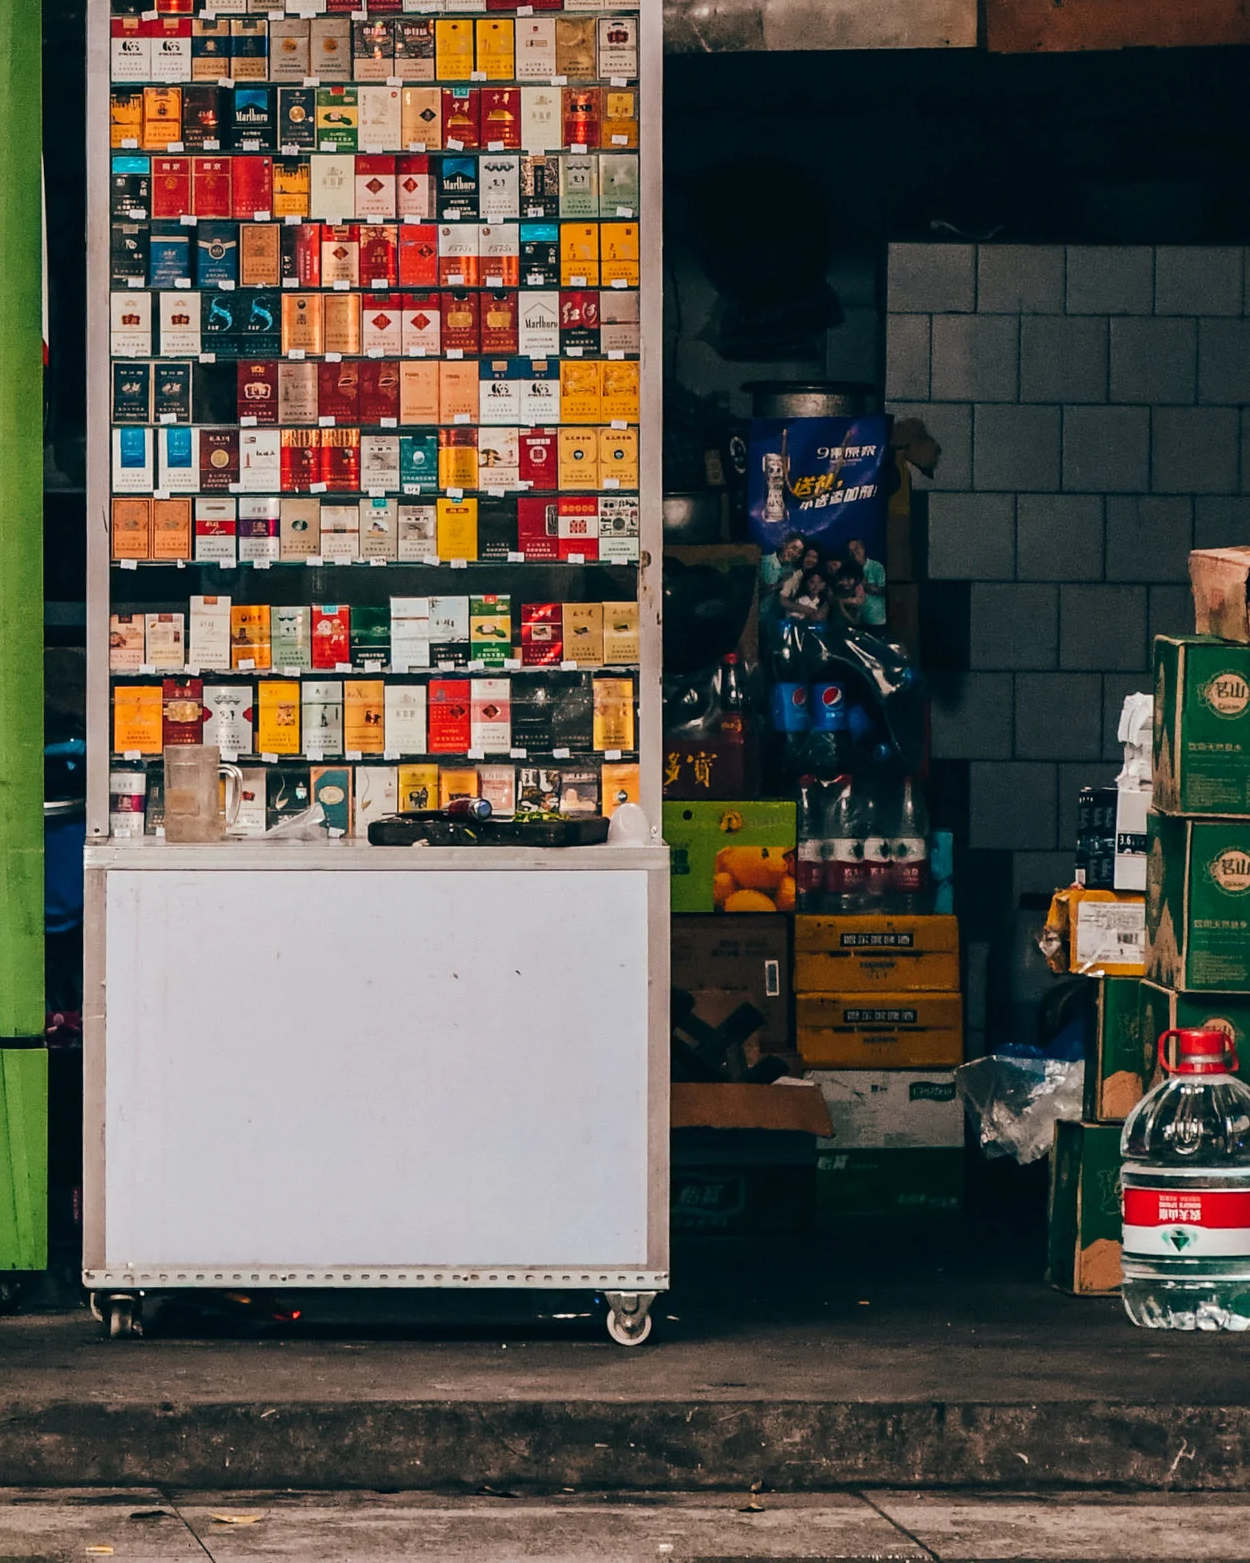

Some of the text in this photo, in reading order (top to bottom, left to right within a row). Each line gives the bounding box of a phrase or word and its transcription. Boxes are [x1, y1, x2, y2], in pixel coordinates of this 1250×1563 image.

[235, 108, 268, 122] Marlboro
[443, 176, 476, 190] Marlboro
[525, 315, 558, 329] Marlboro
